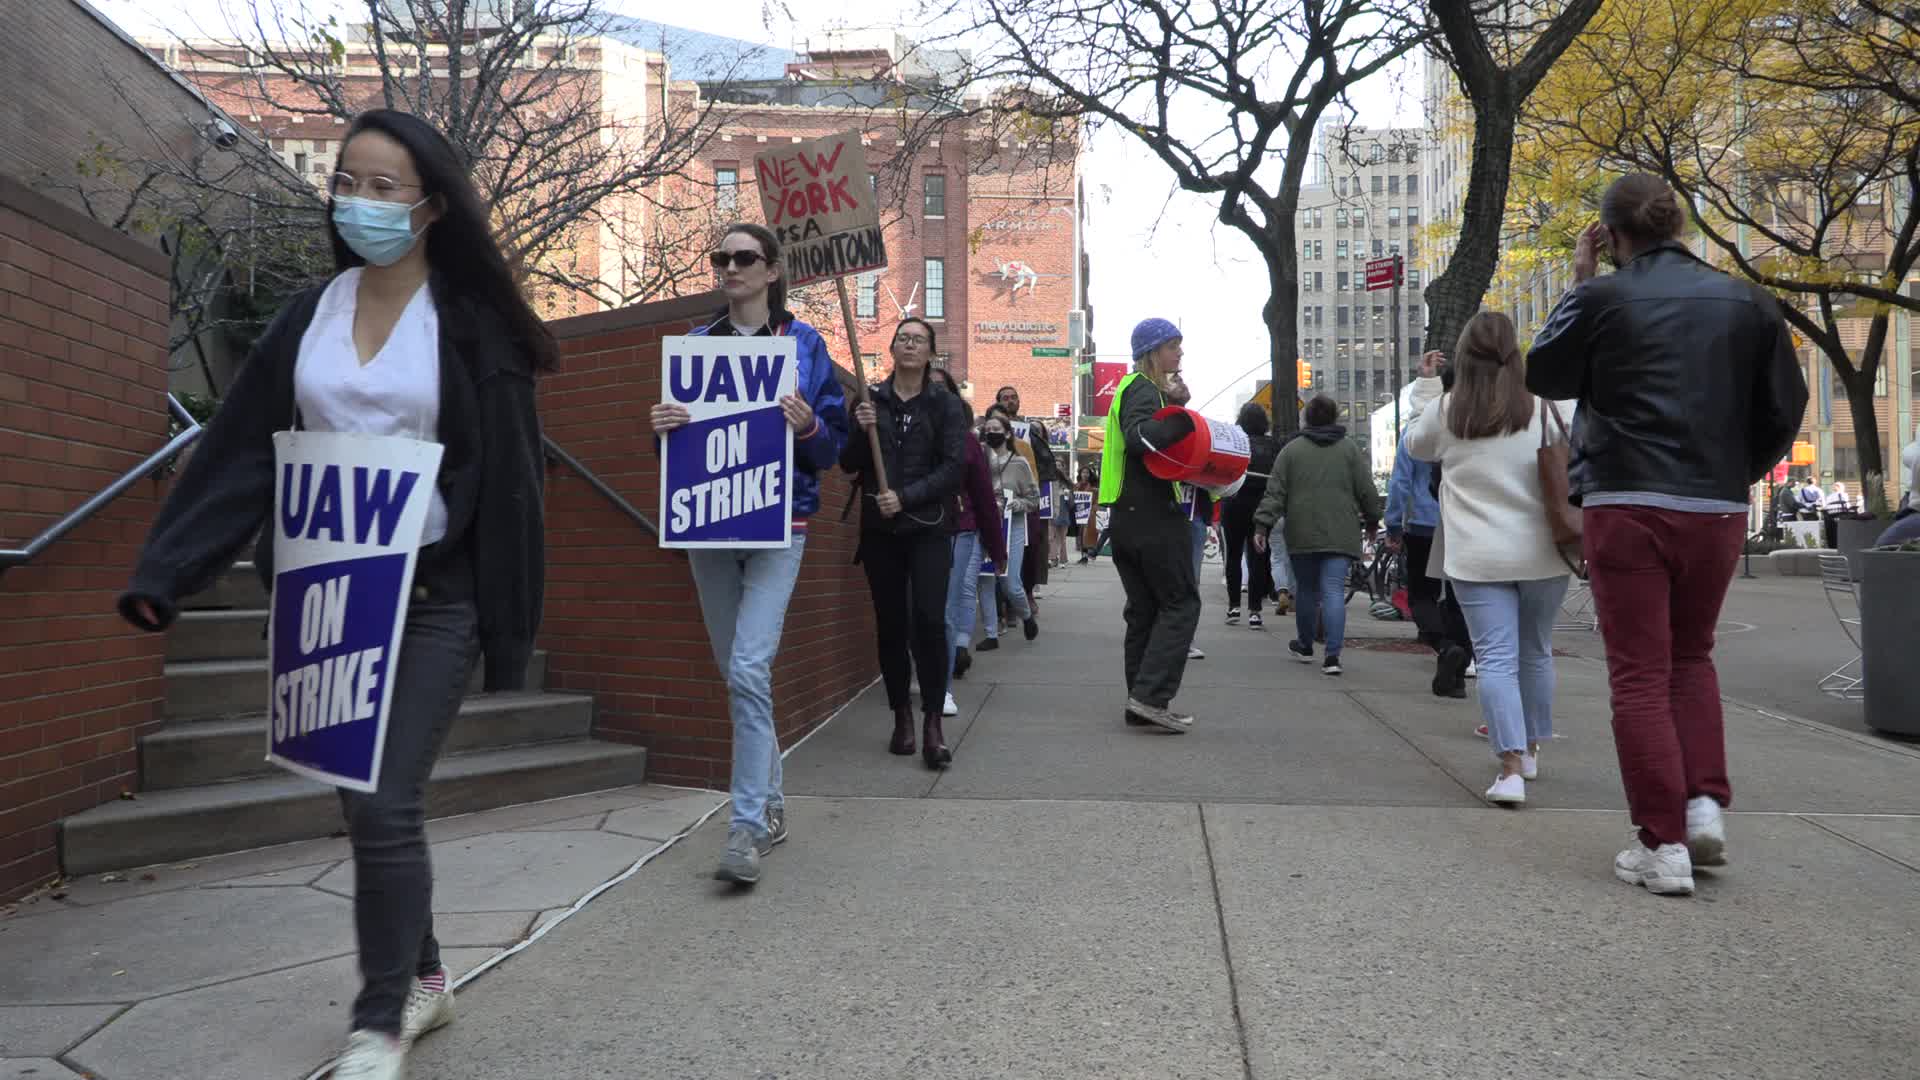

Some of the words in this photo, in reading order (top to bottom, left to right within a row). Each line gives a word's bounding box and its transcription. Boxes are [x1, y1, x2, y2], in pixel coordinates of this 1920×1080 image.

[757, 141, 845, 191] NEW
[768, 175, 859, 225] YORK
[669, 355, 786, 403] UAW
[705, 420, 749, 474] ON
[281, 463, 420, 547] UAW
[671, 460, 781, 534] STRIKE
[300, 574, 351, 655] ON
[273, 645, 384, 745] STRIKE
